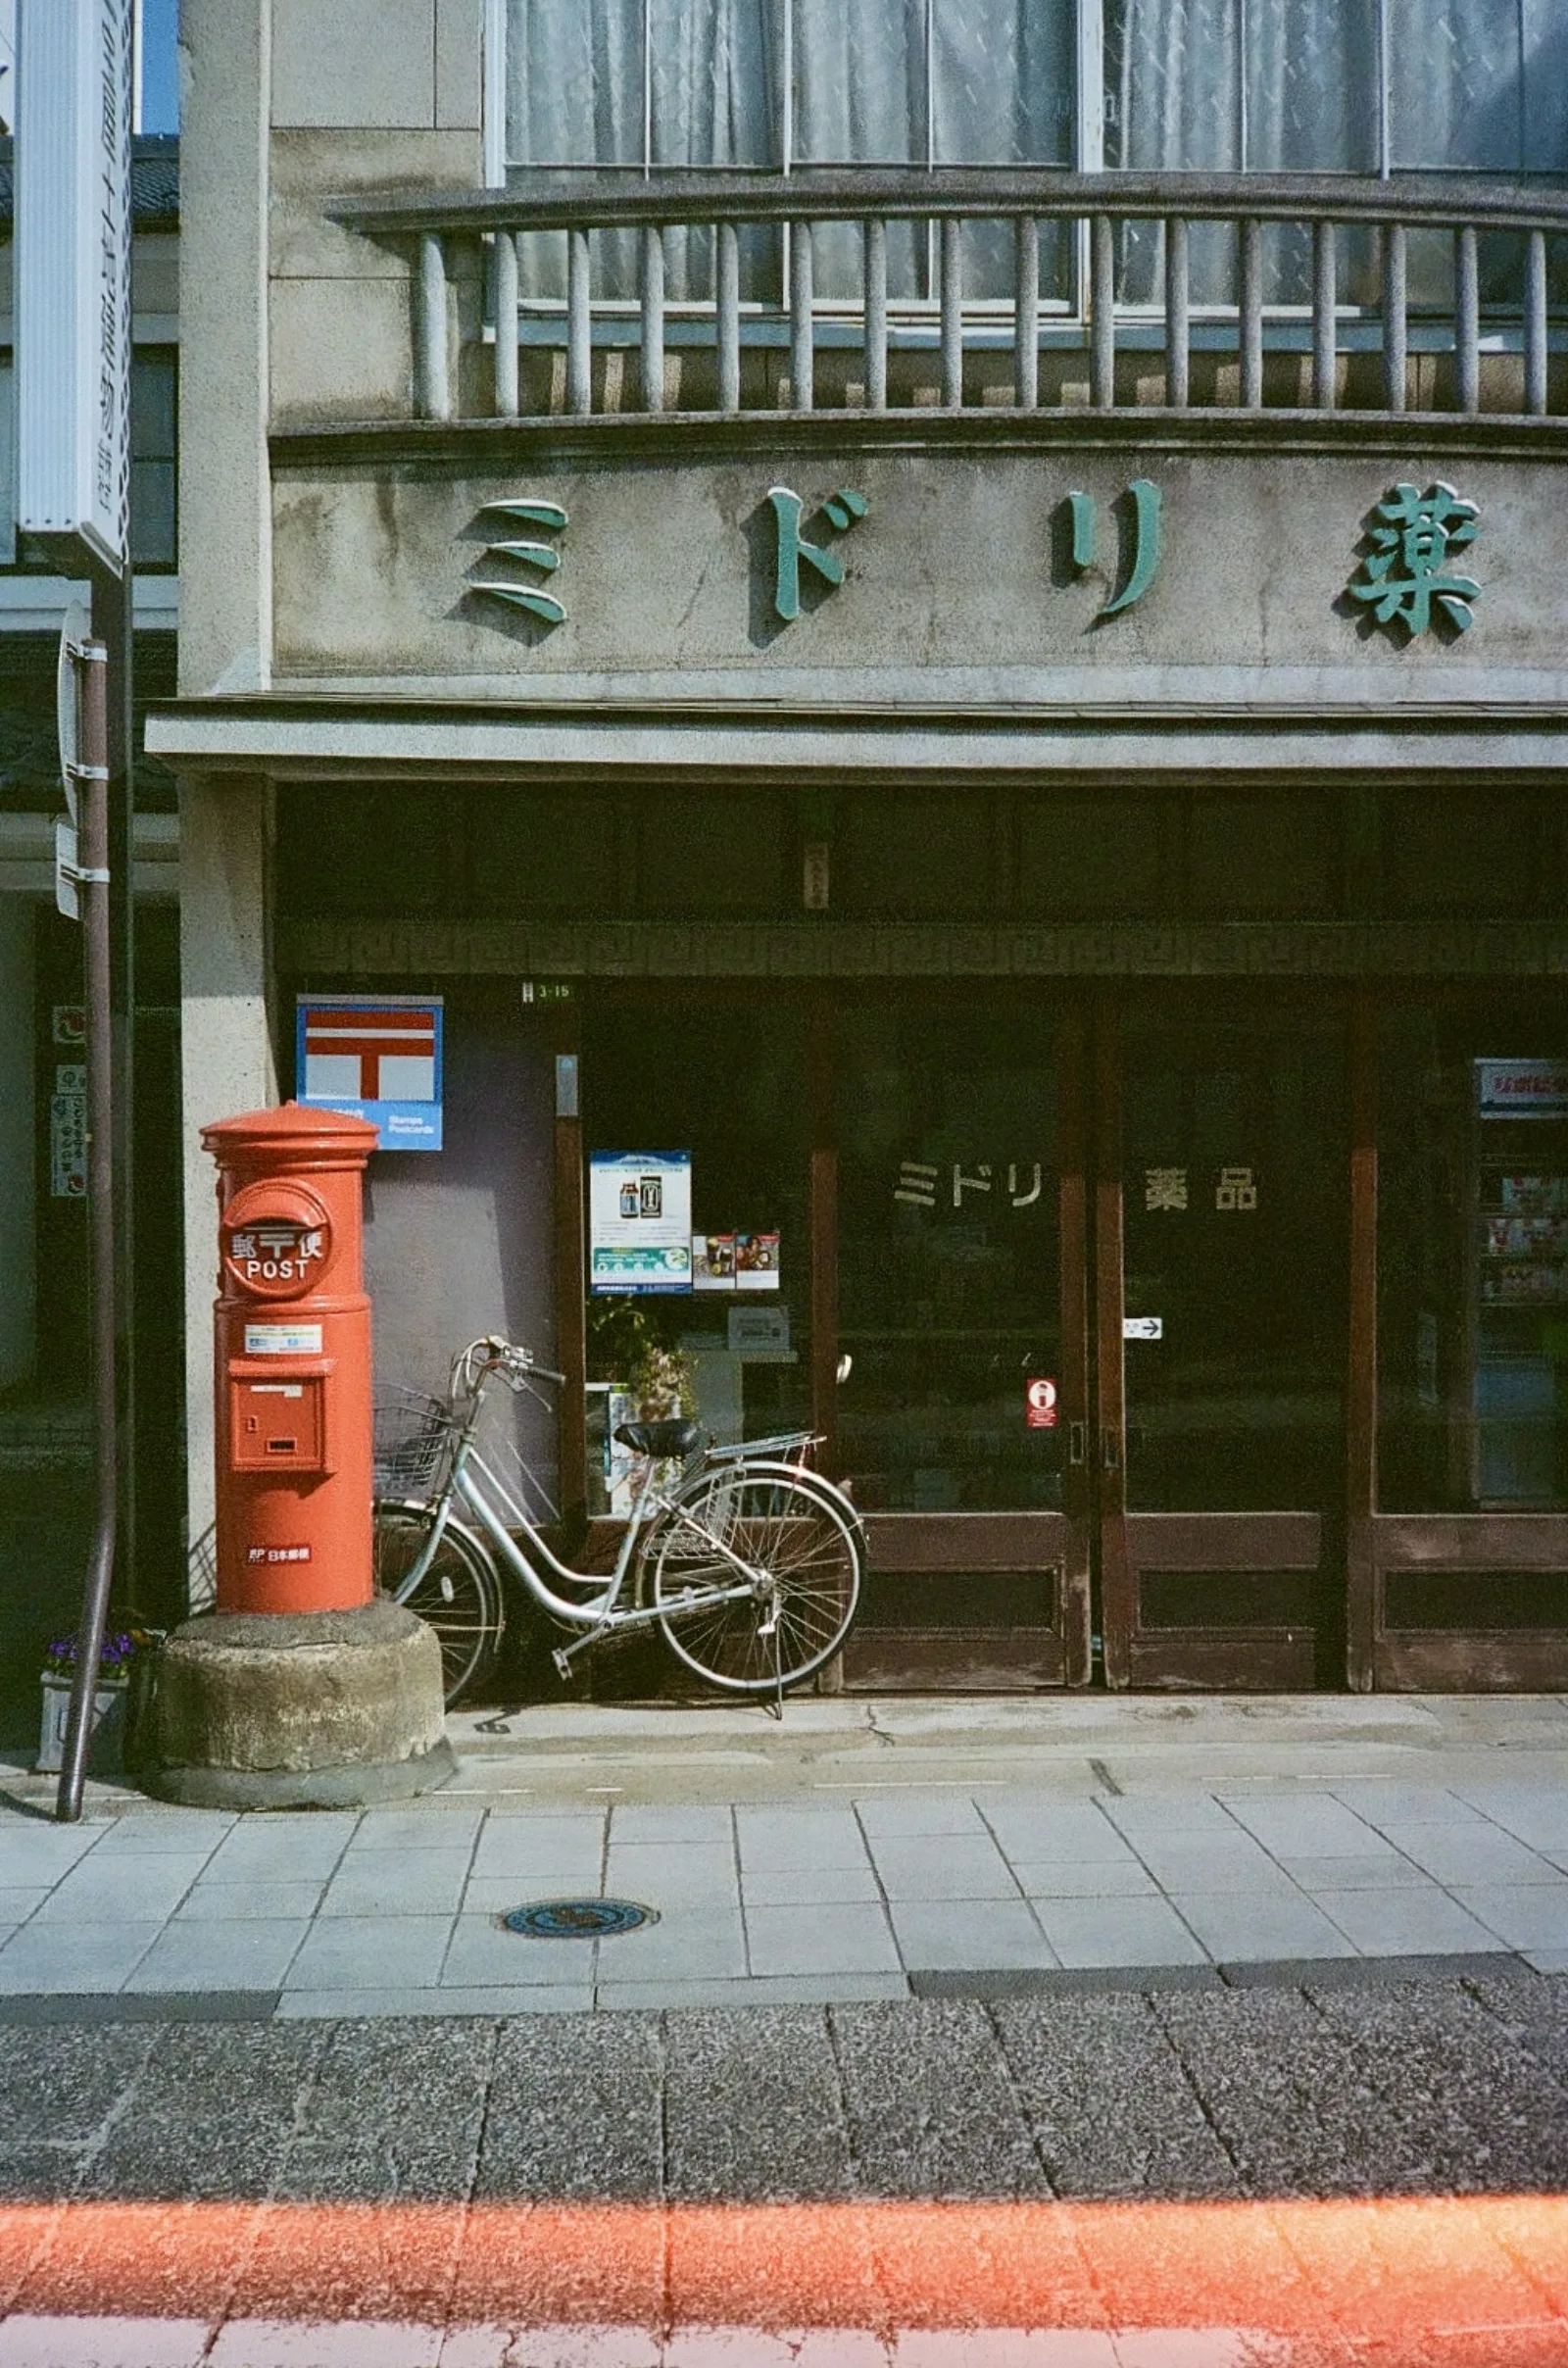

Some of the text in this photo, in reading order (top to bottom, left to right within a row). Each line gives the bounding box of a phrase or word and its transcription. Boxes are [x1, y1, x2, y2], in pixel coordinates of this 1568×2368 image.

[468, 479, 1483, 636] ミドリ薬
[894, 1161, 1257, 1210] ミドリ 薬品
[247, 1260, 310, 1279] POST
[268, 1548, 310, 1561] 日本郵便
